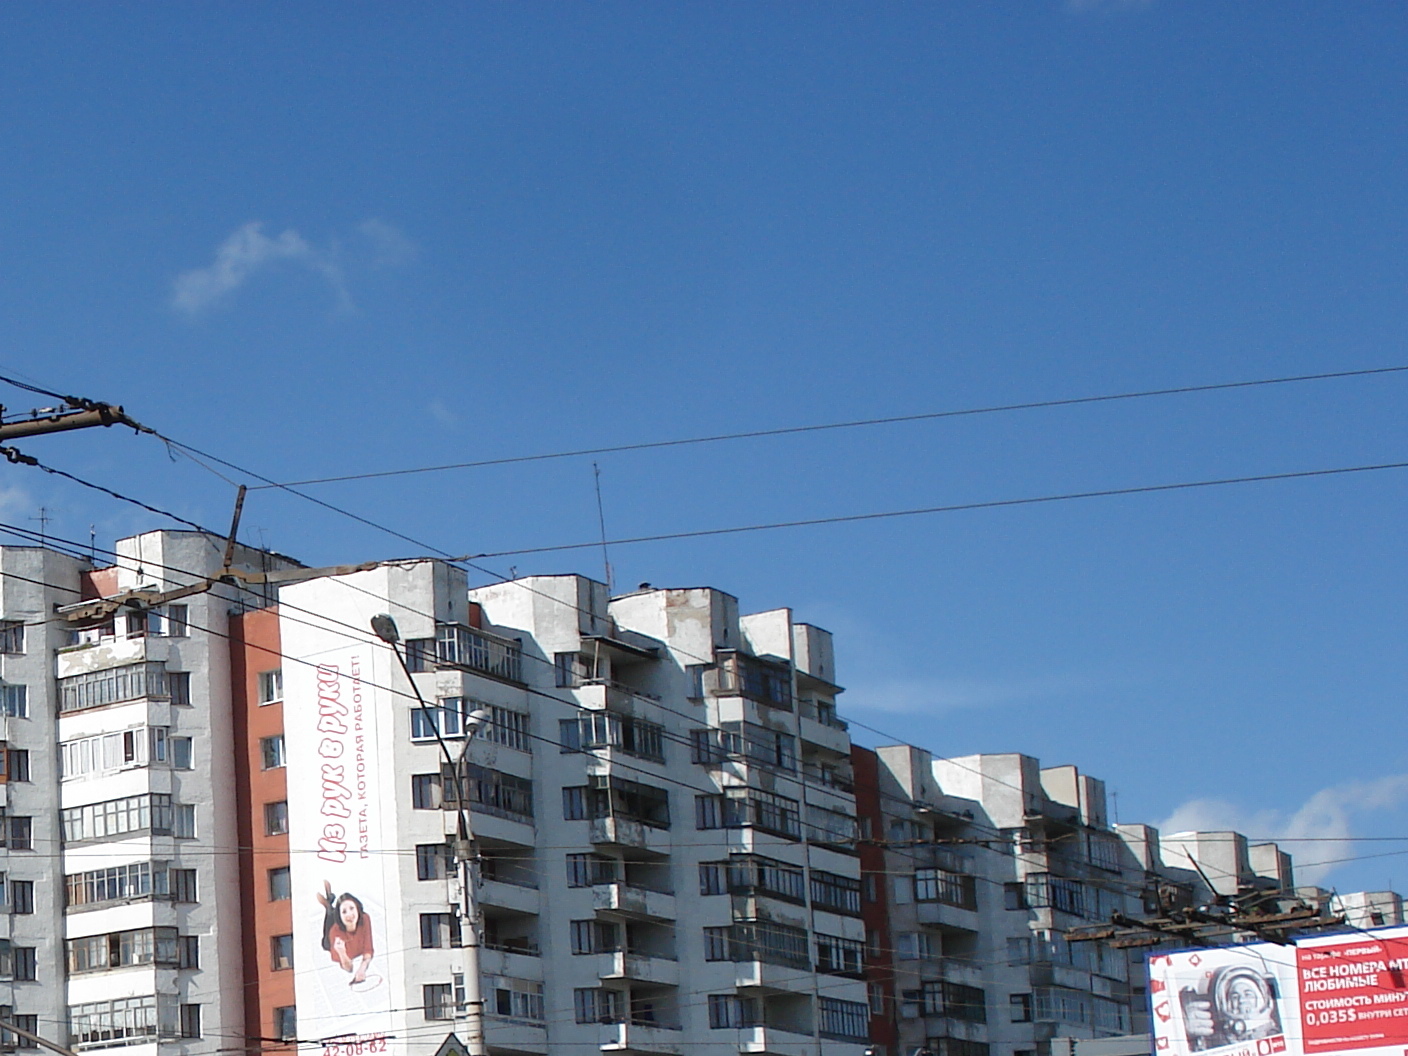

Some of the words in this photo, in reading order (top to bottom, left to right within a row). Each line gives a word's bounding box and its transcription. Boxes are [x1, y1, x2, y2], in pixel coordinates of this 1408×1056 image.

[317, 663, 349, 735] руки
[350, 654, 364, 732] РАБОТАЕТ!
[318, 737, 345, 760] в
[355, 735, 367, 800] КОТОРАЯ
[320, 763, 353, 819] рук
[317, 823, 348, 864] Из
[357, 803, 370, 860] ГАЗЕТА,
[1302, 966, 1327, 980] ВСЕ
[1329, 960, 1388, 977] НОМЕРА
[1303, 974, 1379, 993] ЛЮБИМЫЕ
[1305, 995, 1372, 1011] СТОИМОСТЬ
[1305, 1008, 1357, 1026] 0,035$
[1357, 1009, 1392, 1021] ВНУТРИ
